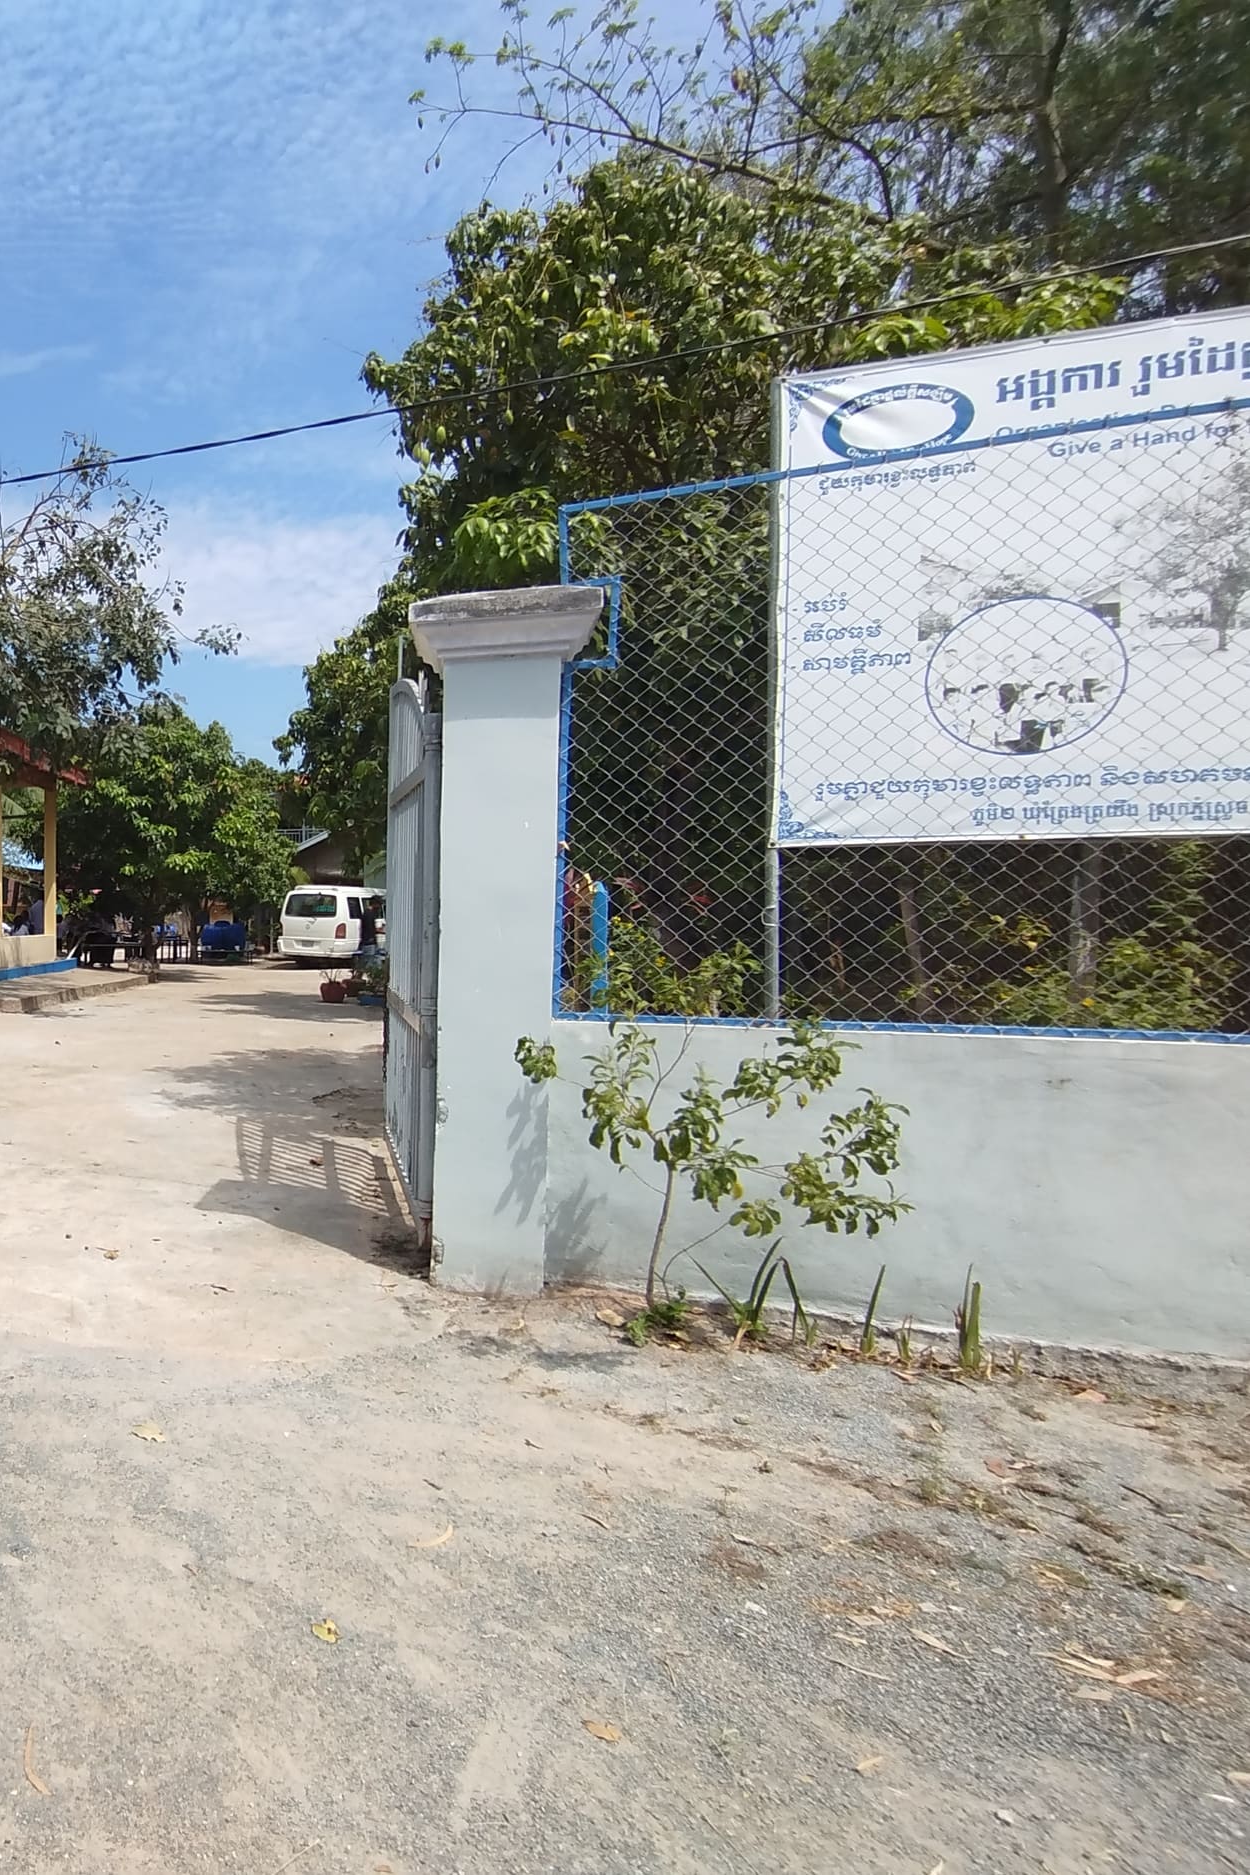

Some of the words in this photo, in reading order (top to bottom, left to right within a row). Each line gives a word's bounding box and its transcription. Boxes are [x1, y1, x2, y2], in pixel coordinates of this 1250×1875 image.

[996, 360, 1122, 411] អង្គការ
[1048, 440, 1101, 458] Give
[1110, 438, 1123, 451] a
[1133, 426, 1196, 448] Hand
